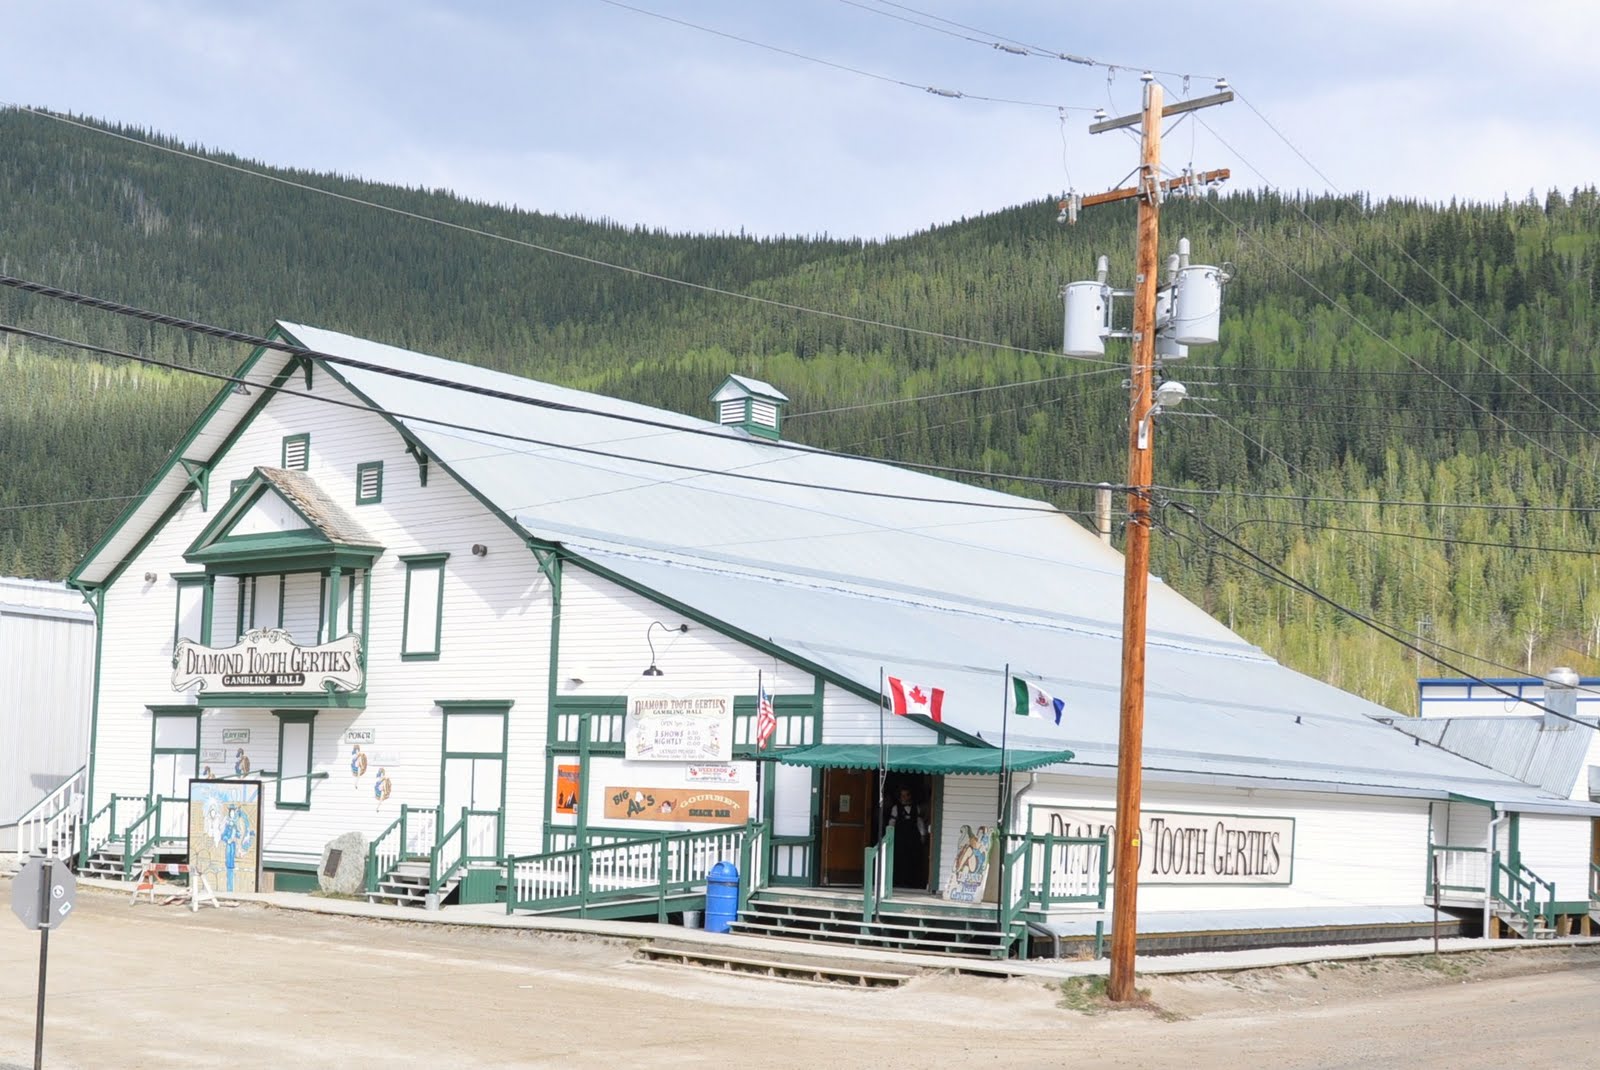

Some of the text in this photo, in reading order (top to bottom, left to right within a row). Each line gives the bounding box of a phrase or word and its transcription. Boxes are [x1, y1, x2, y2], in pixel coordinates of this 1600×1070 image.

[186, 646, 351, 675] DIAMOND TOOTH GERTIES
[224, 674, 303, 685] GAMBLING HALL
[634, 700, 669, 716] DIAMOND
[671, 699, 693, 709] TOOTH
[348, 731, 371, 740] POKER
[612, 789, 656, 818] BIG AL'S
[680, 793, 740, 810] GOURMET
[688, 809, 731, 818] SNACK BAR
[1150, 817, 1207, 876] TOOTH
[1213, 821, 1281, 877] GERTIES
